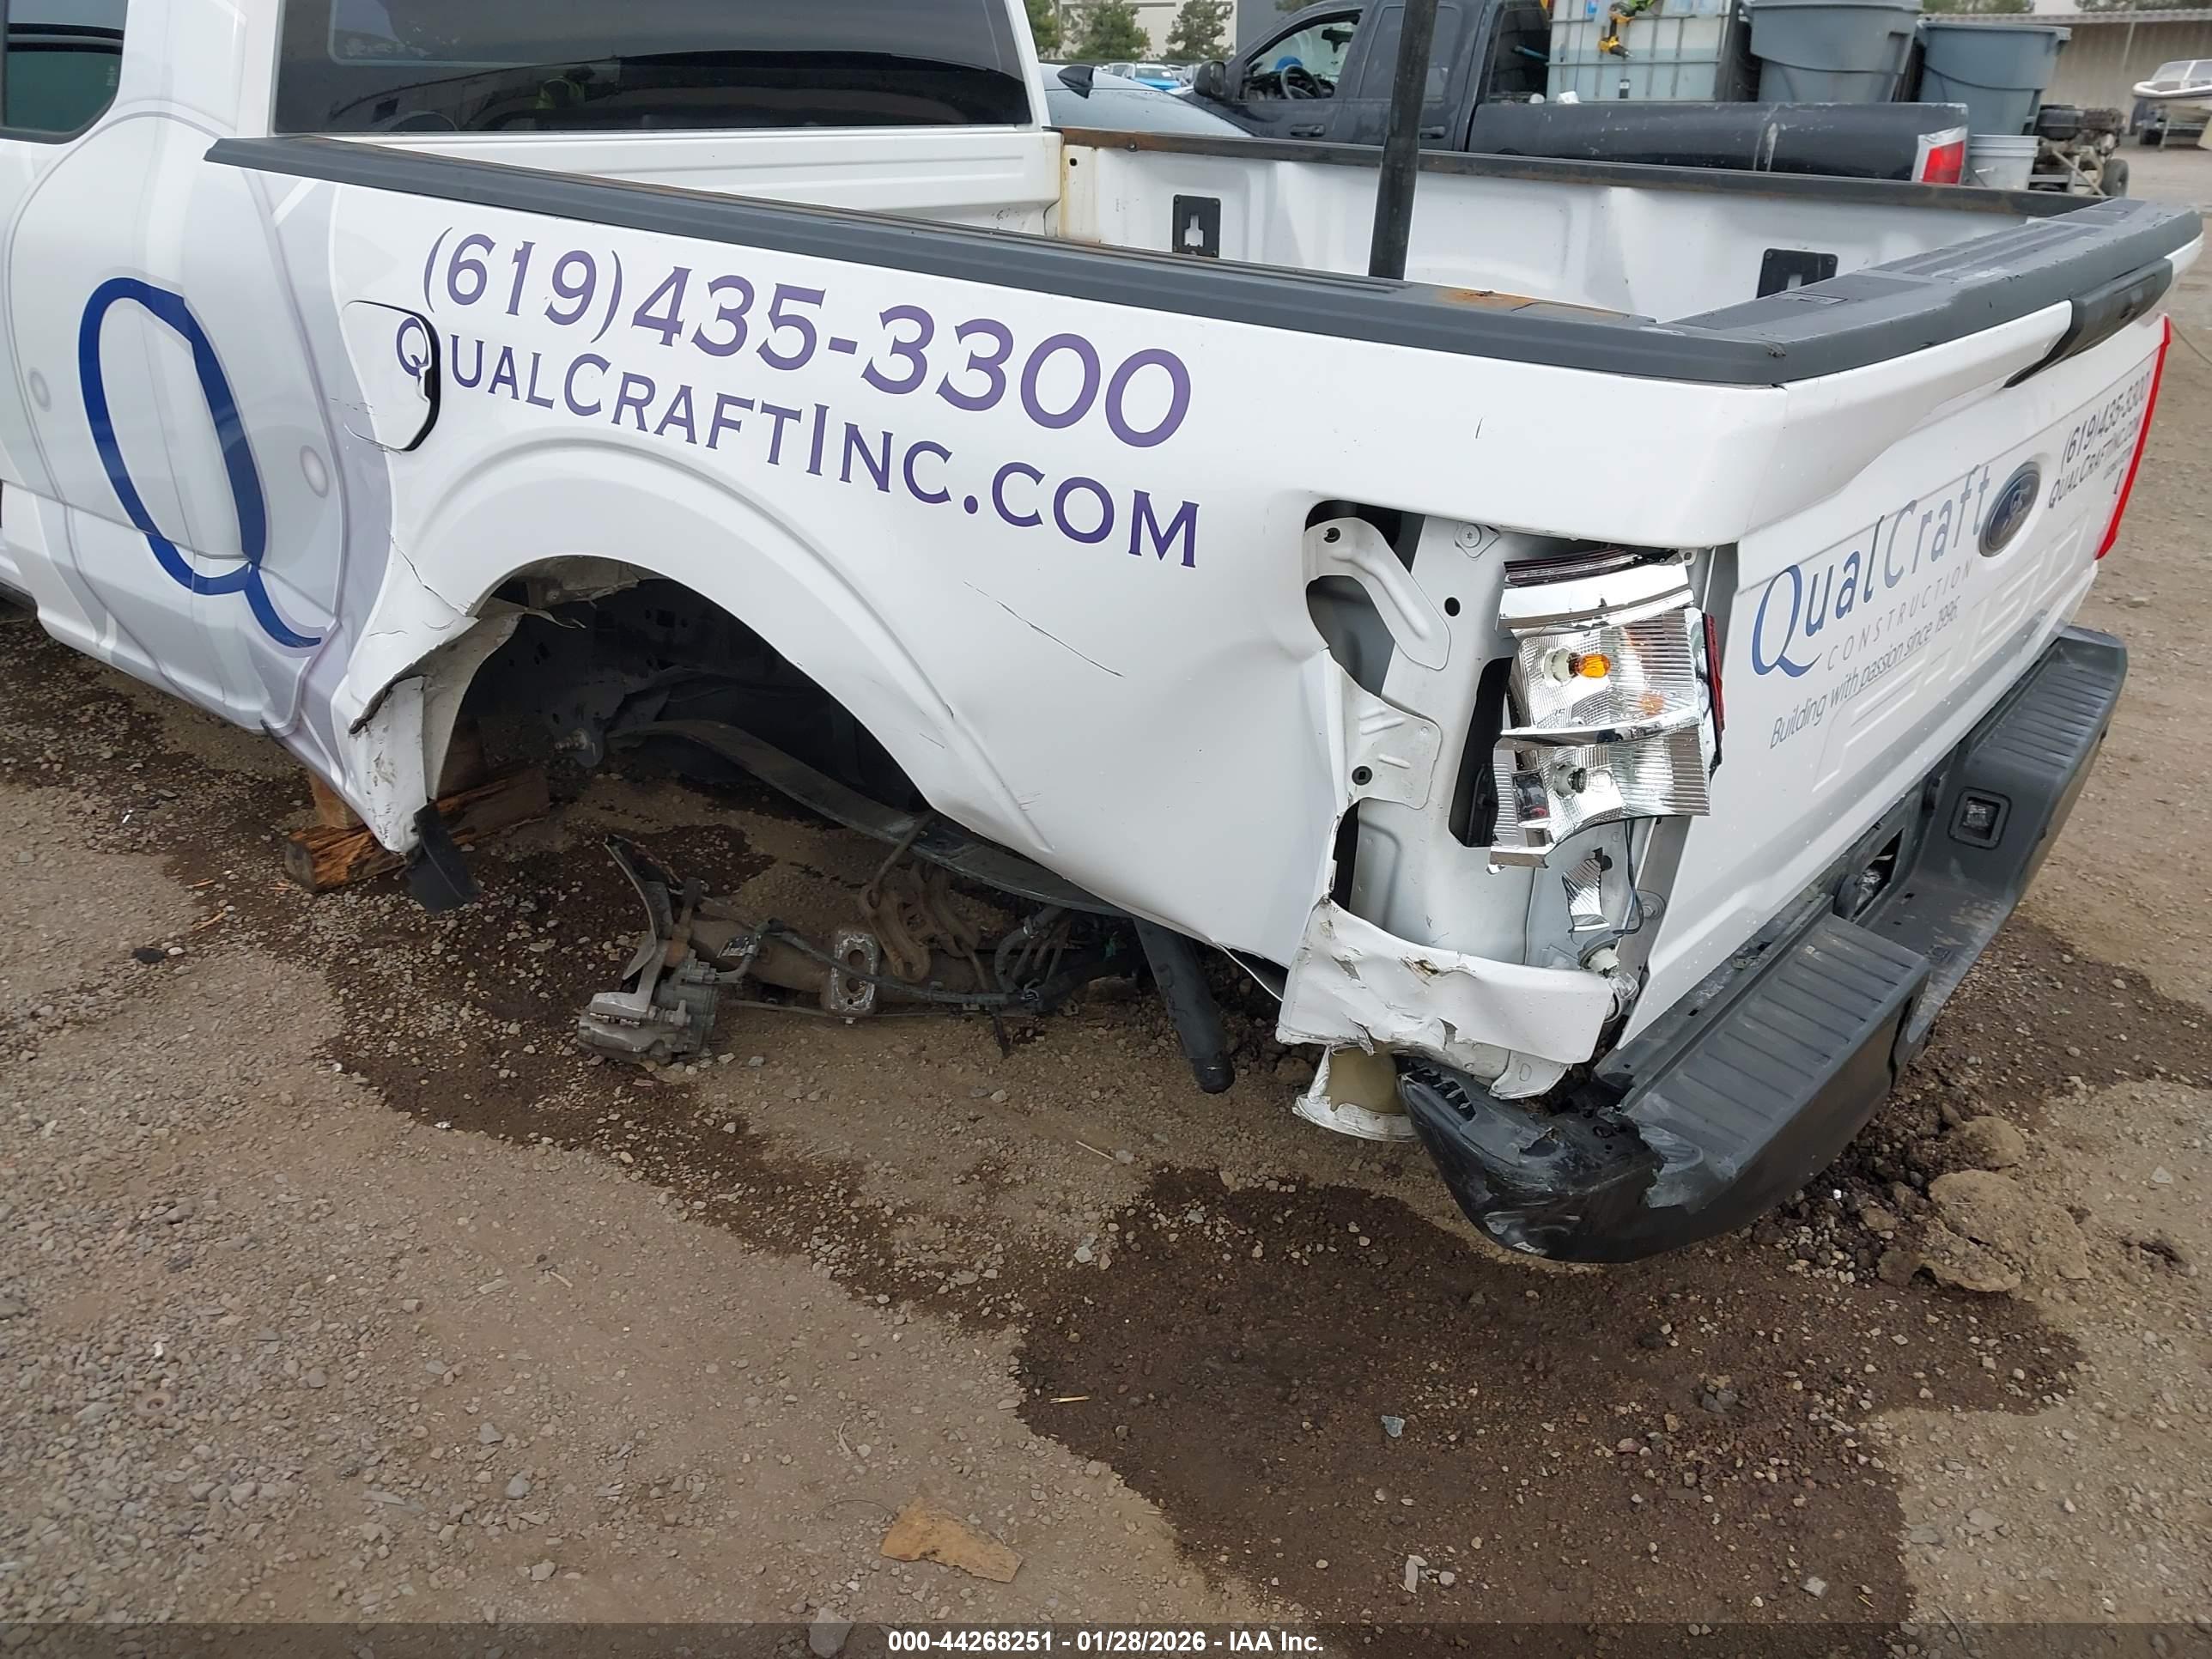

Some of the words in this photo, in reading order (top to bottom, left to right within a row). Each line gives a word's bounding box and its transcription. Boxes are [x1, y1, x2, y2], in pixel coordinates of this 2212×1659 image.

[423, 226, 1192, 447] (619)435-3300
[79, 276, 323, 648] Q
[1751, 464, 1990, 678] QualCraft
[1826, 556, 1973, 671] CONSTRUCTION
[1770, 693, 1828, 750] Building
[1829, 666, 1859, 708] with
[1859, 642, 1905, 690] passion
[1903, 621, 1933, 657] since
